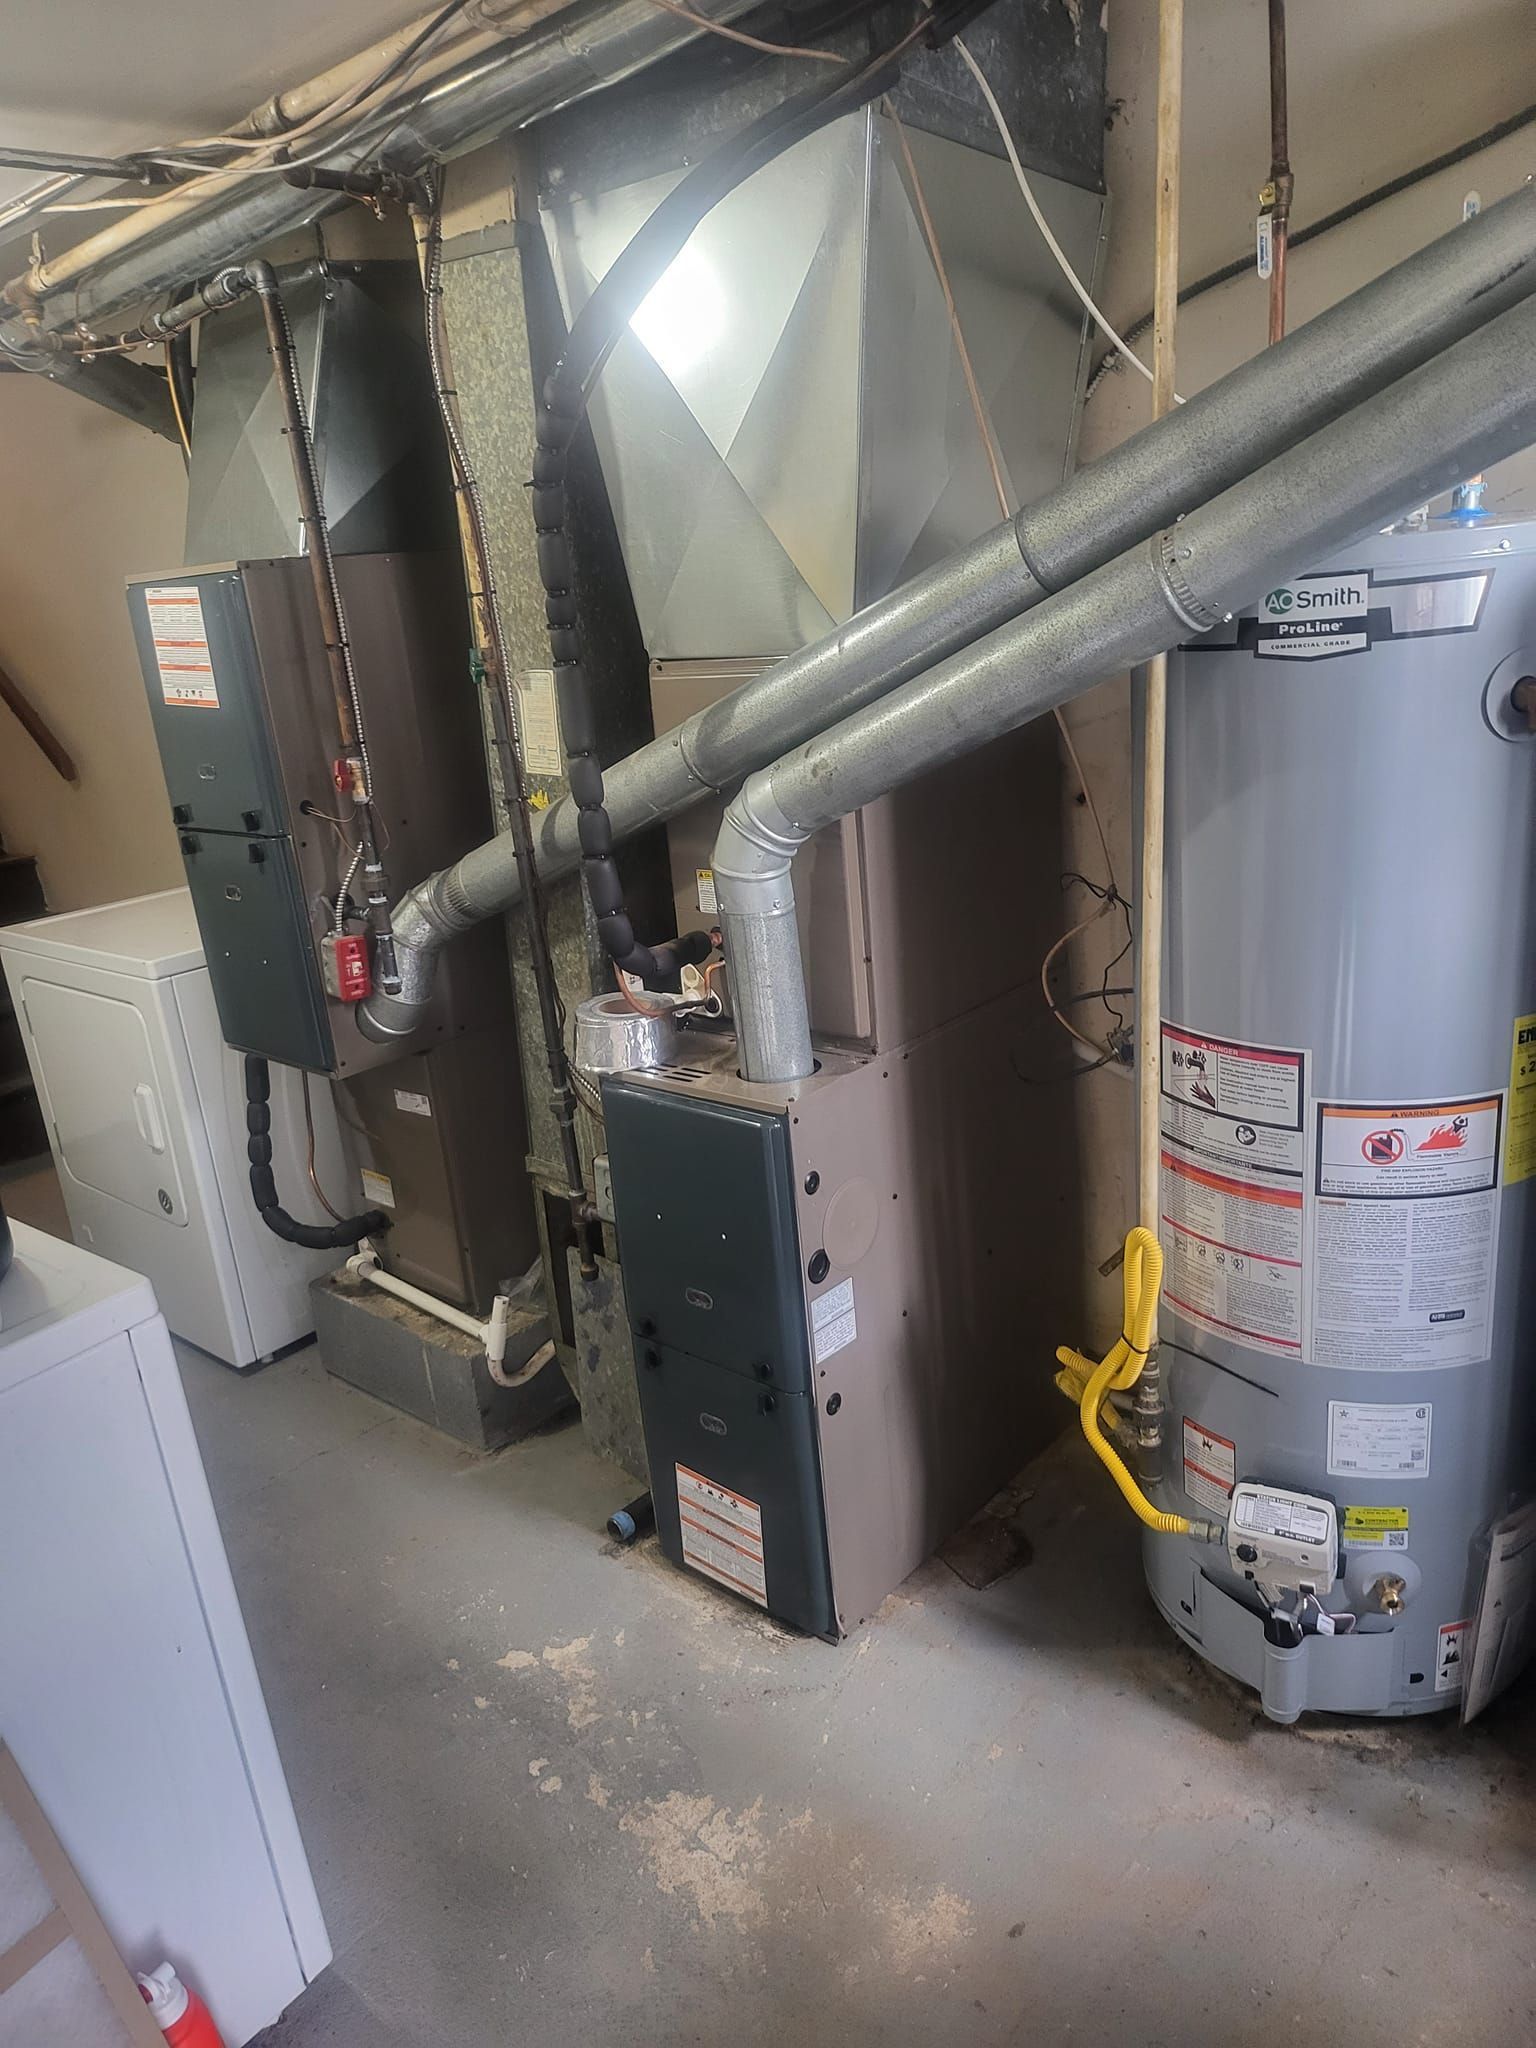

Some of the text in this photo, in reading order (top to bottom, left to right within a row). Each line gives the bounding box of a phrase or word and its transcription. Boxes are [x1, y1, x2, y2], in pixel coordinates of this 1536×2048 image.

[1267, 586, 1361, 611] AO Smith
[1279, 621, 1340, 635] ProLine
[1271, 639, 1351, 650] COMMERCIAL GRADE
[1209, 1043, 1239, 1057] DANGER
[1400, 1109, 1440, 1118] WARNING
